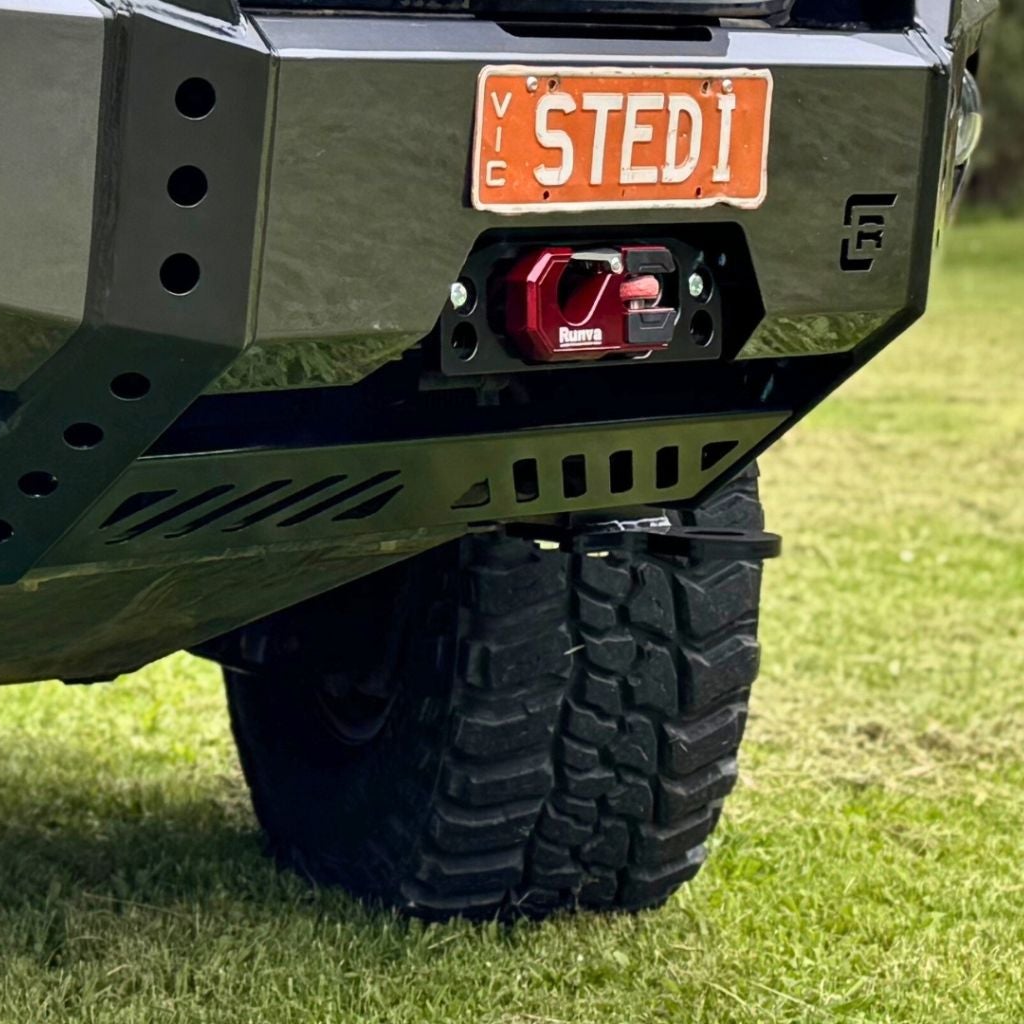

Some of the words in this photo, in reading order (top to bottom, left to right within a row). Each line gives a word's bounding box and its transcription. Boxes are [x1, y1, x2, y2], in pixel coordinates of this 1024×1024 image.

[485, 91, 513, 187] VIC
[532, 91, 736, 187] STEDI
[559, 326, 603, 344] Runva
